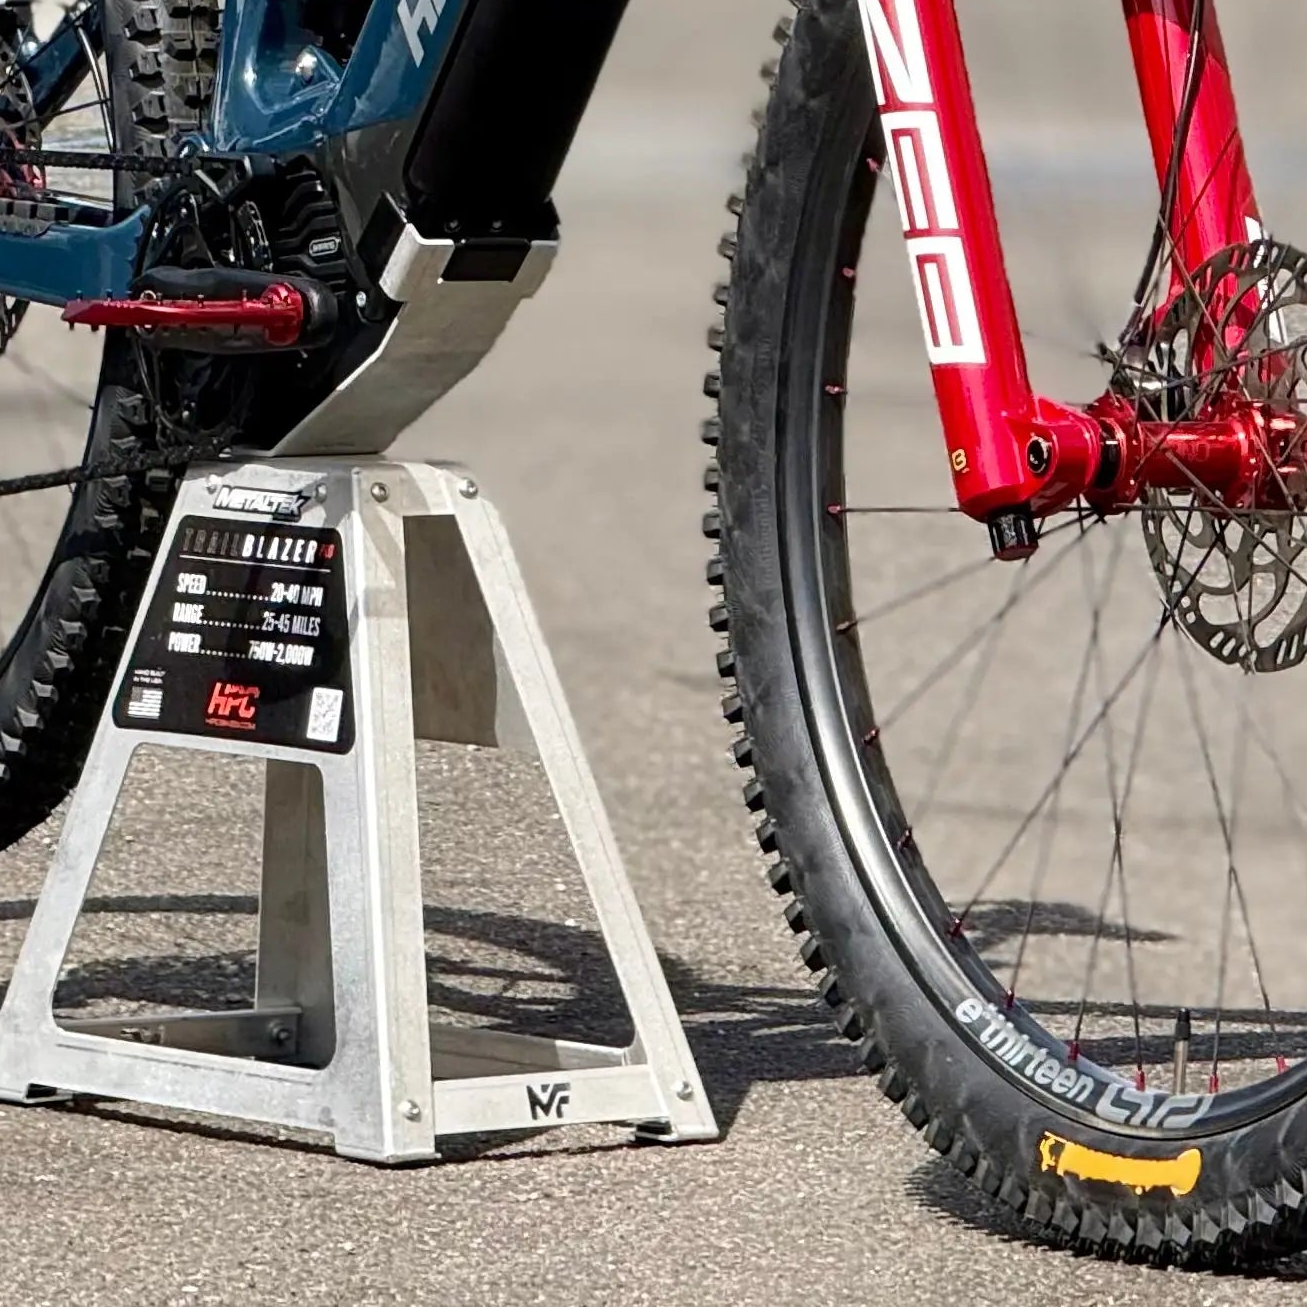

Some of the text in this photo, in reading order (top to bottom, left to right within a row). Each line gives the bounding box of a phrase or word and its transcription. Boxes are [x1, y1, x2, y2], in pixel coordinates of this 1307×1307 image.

[177, 573, 207, 595] SPEED
[172, 602, 204, 625] RANGE
[291, 614, 321, 637] MILES
[167, 631, 202, 654] POWER
